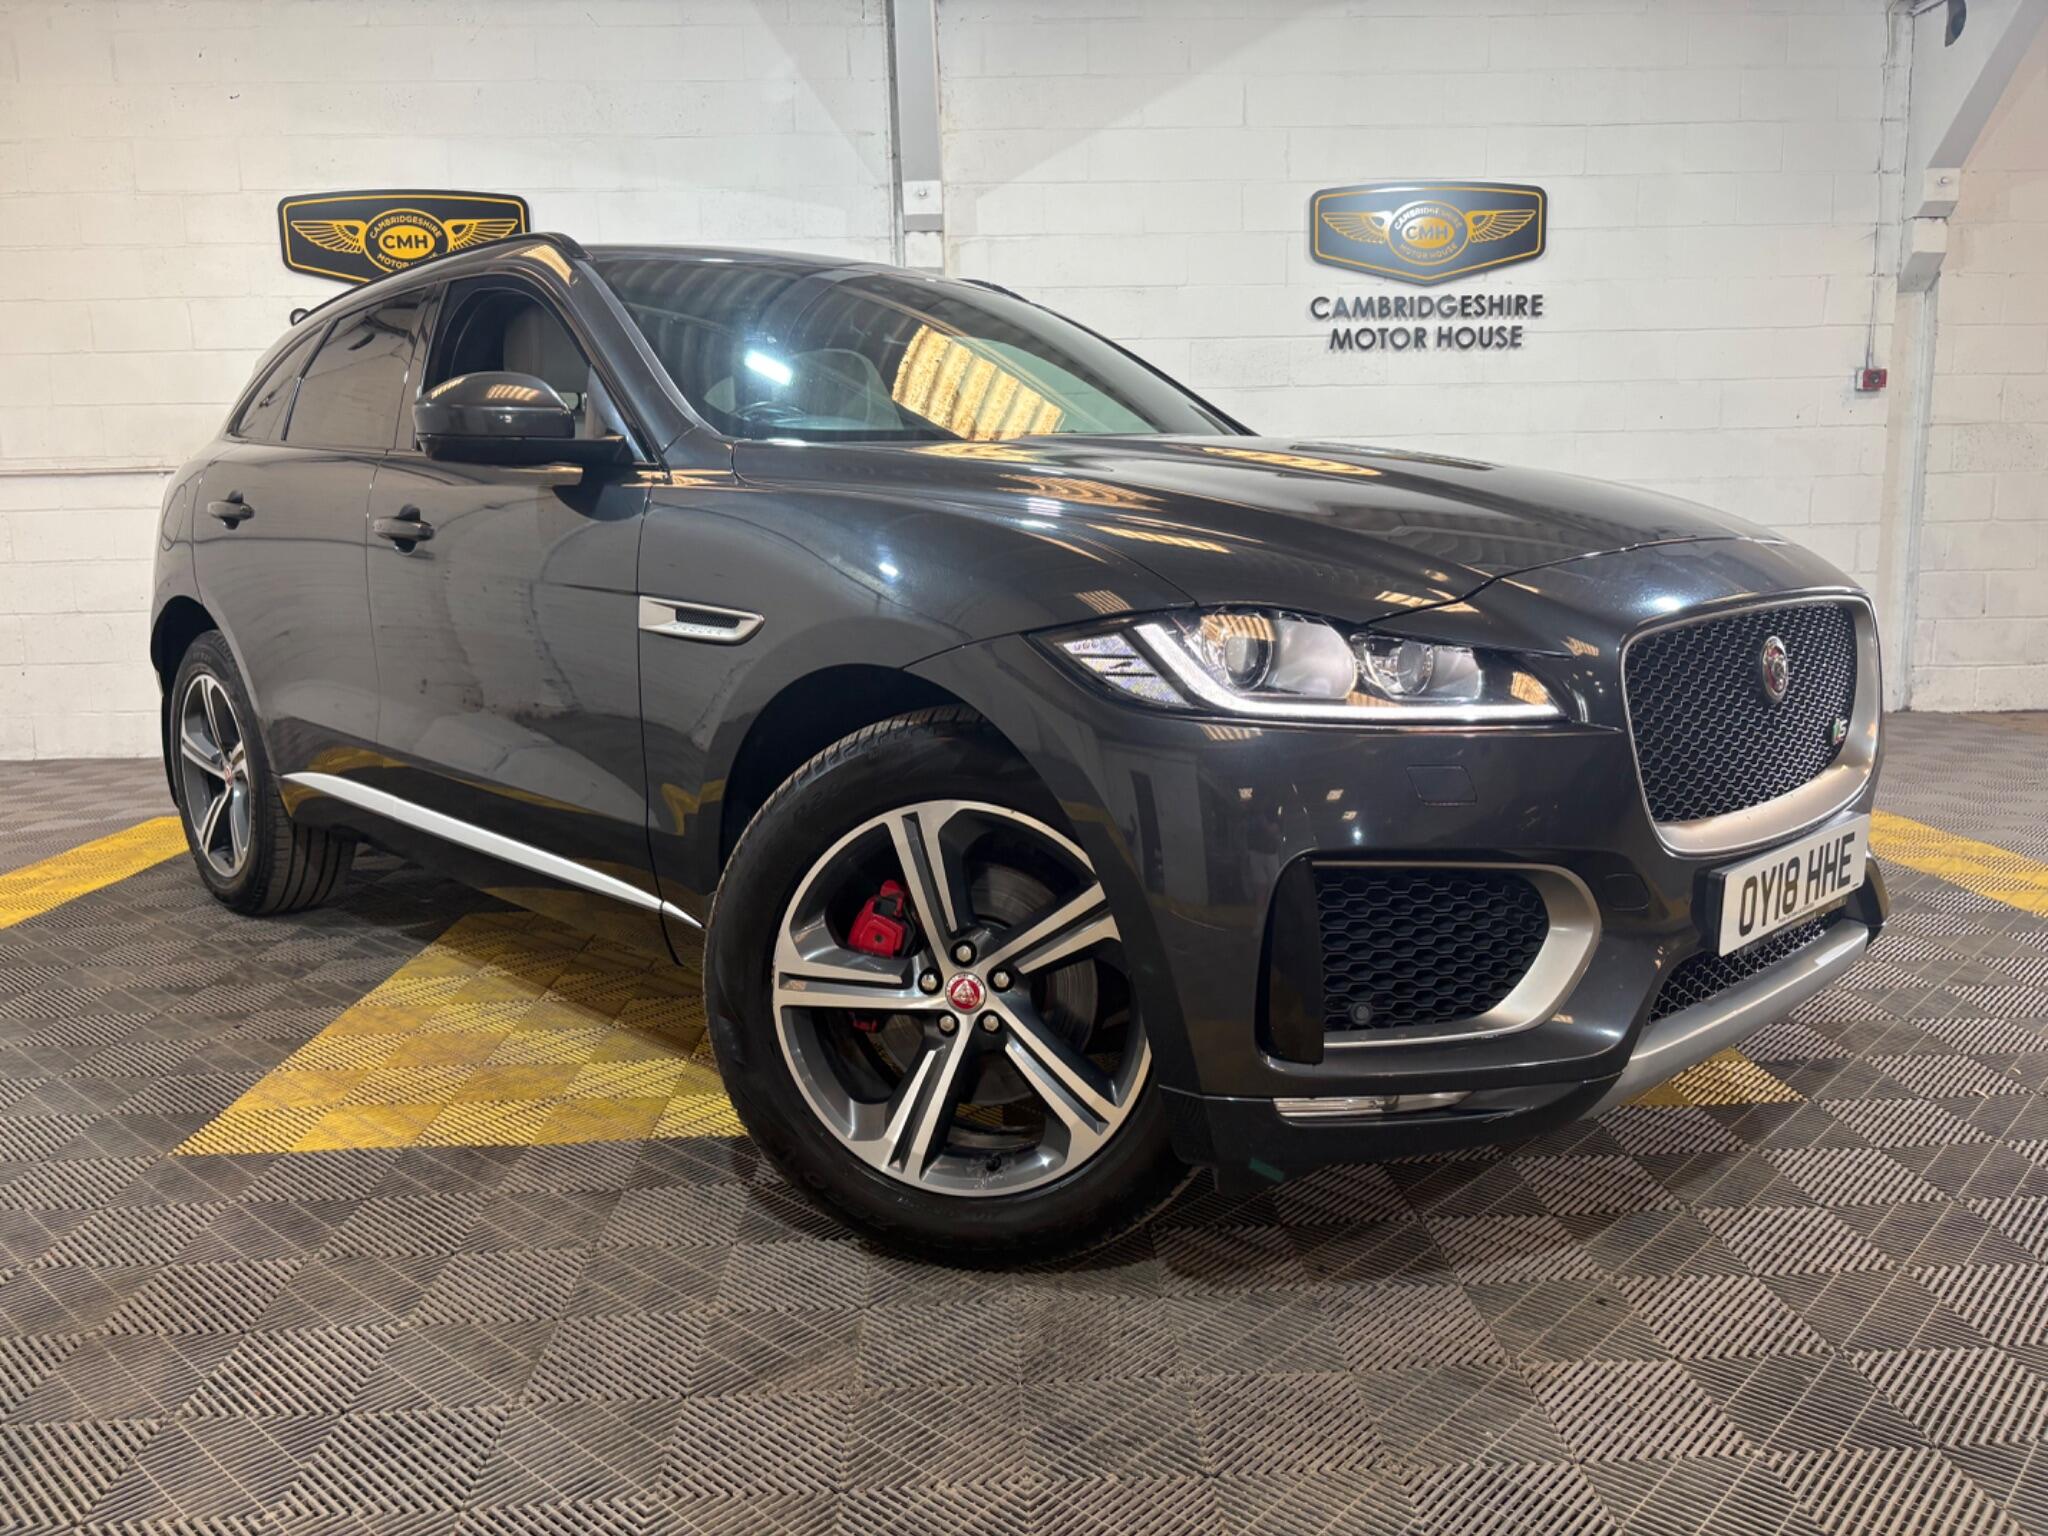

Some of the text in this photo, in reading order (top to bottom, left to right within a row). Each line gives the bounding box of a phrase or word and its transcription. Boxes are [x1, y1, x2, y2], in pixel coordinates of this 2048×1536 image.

[370, 215, 442, 238] CAMBRIDGESHIRE
[1406, 225, 1448, 240] CMH
[383, 235, 428, 249] CMH
[1310, 294, 1543, 319] CAMBRIDGESHIRE
[1329, 326, 1523, 350] MOTOR HOUSE
[1739, 831, 1855, 937] OY18 HHE
